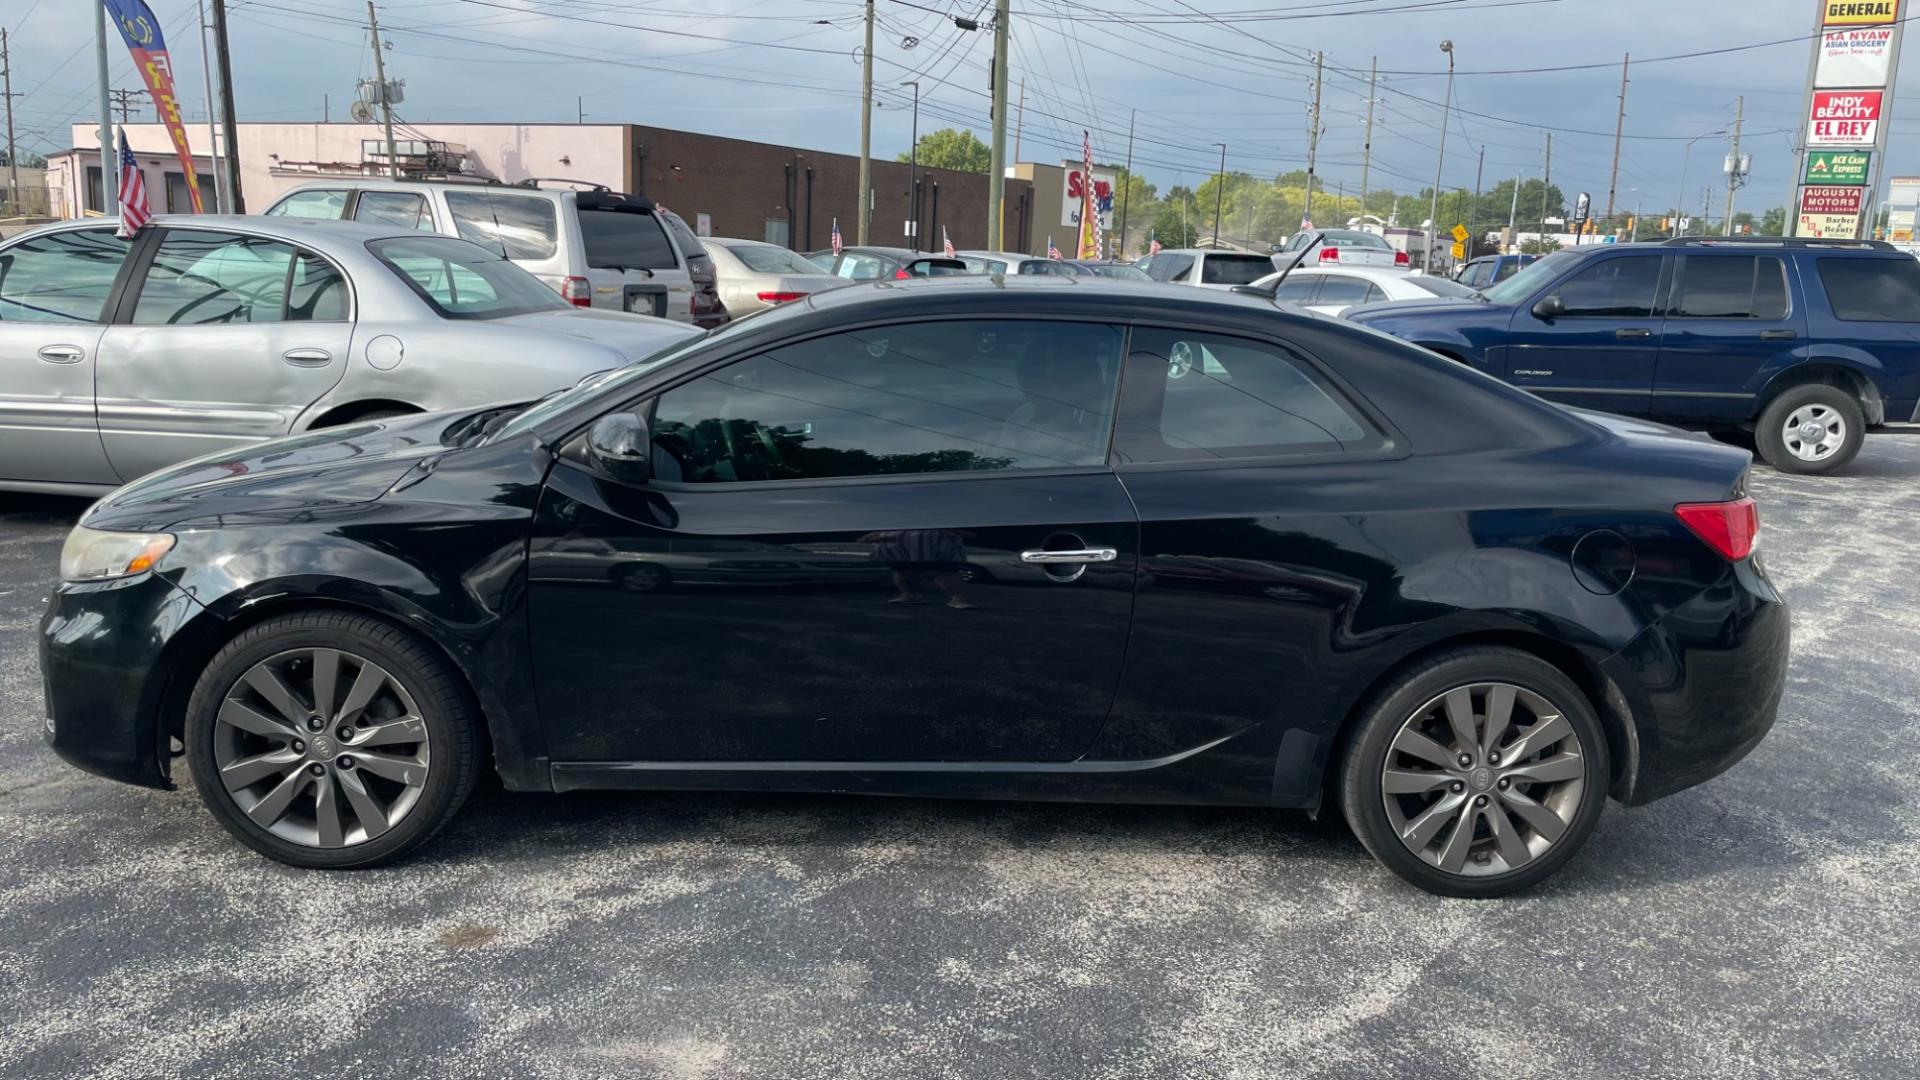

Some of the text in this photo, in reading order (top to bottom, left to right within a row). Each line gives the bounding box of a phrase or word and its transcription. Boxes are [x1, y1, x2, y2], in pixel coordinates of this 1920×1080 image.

[1829, 3, 1891, 16] GENERAL
[1849, 31, 1891, 41] NYAW
[1850, 40, 1887, 48] GROCERY
[1829, 97, 1864, 107] INDY
[1817, 107, 1873, 118] BEAUTY
[1815, 121, 1870, 135] EL REY
[1831, 155, 1847, 165] ACE
[1806, 188, 1860, 197] AUGUSTA
[1808, 198, 1855, 207] MOTORS
[1826, 216, 1855, 224] Barber
